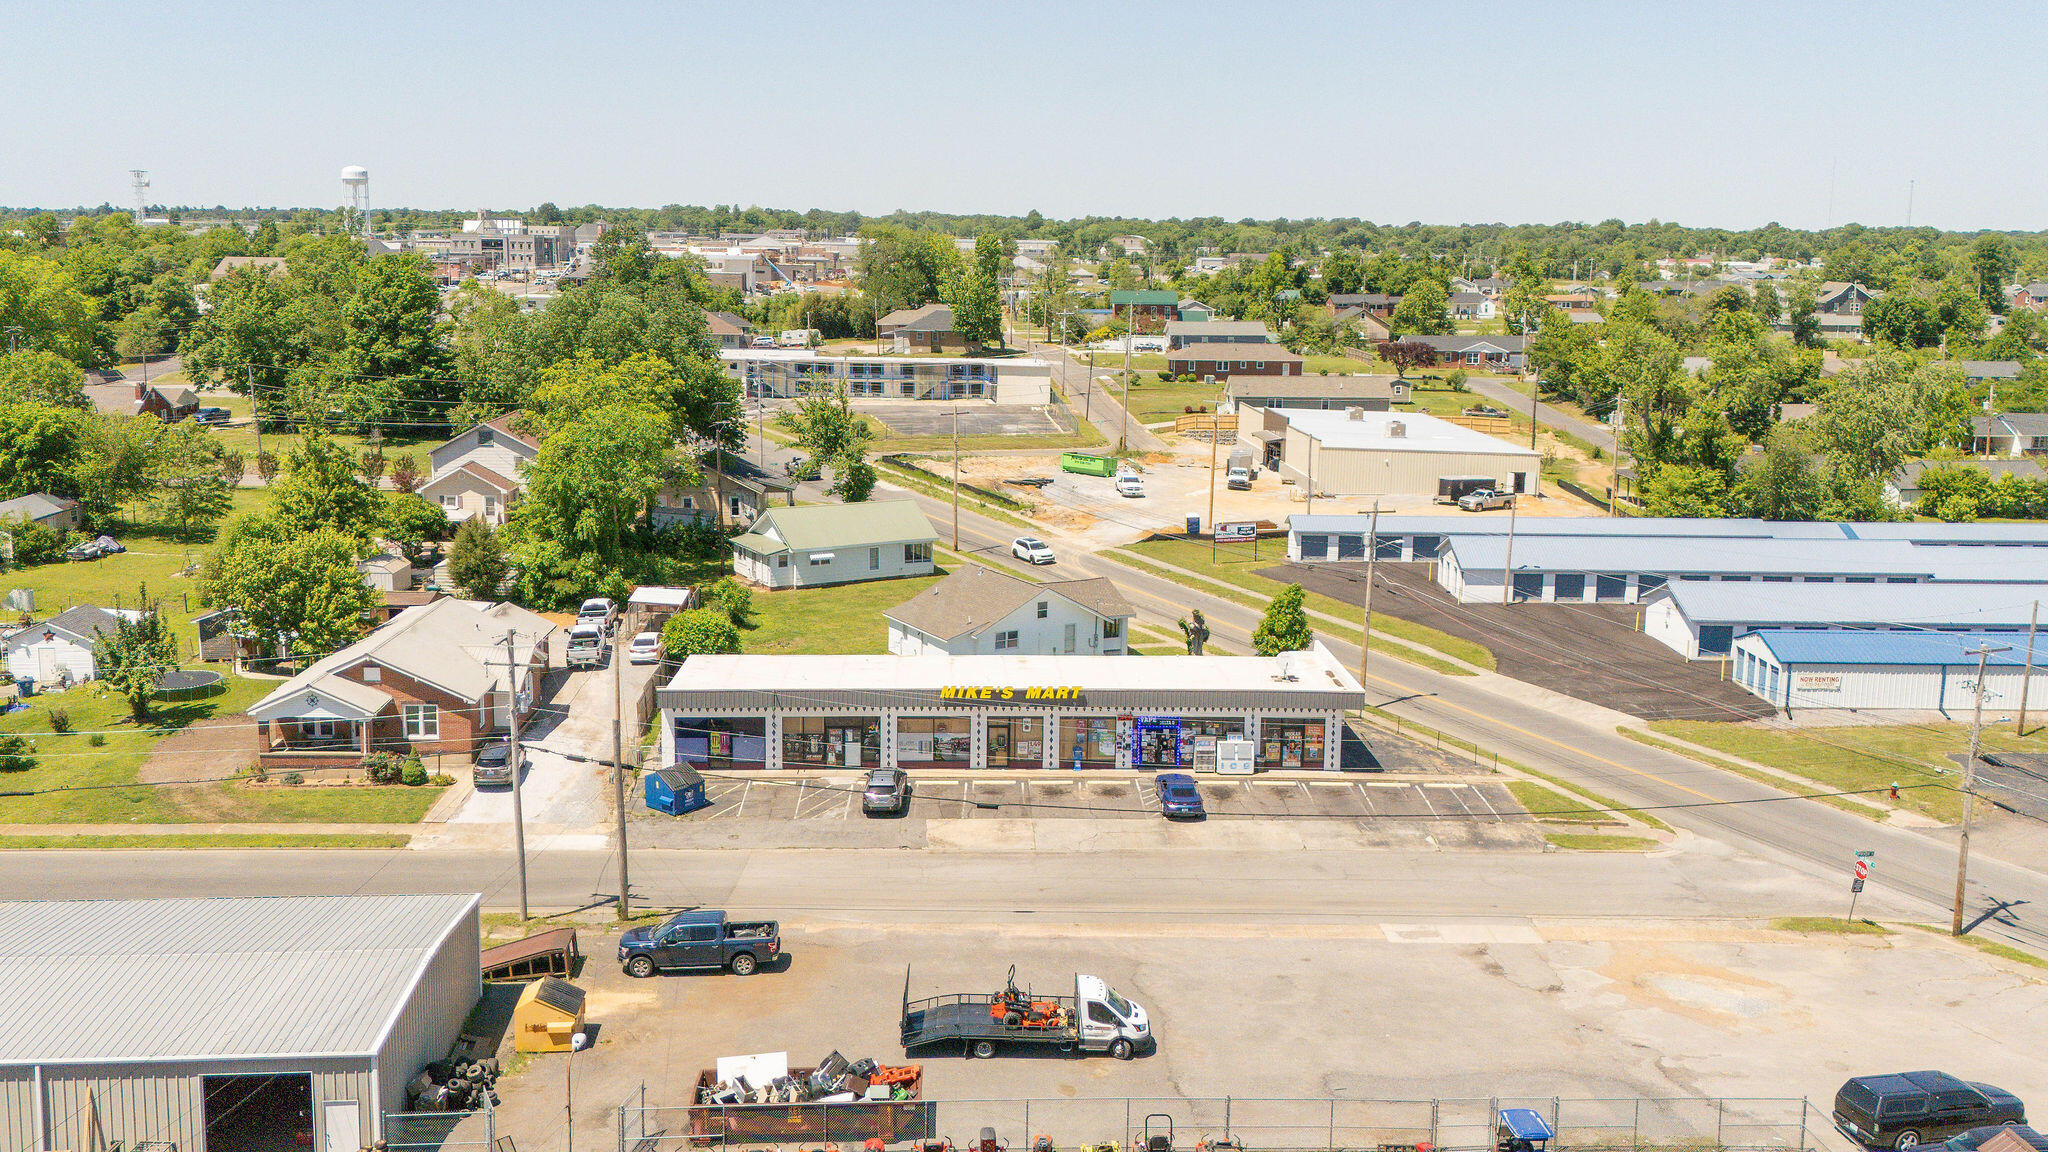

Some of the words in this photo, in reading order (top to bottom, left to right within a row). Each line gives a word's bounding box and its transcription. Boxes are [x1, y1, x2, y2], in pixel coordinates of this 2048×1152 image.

[940, 685, 1014, 699] MIKE'S
[1025, 685, 1082, 699] MART
[1221, 762, 1250, 770] ICE
[1854, 863, 1868, 876] STOP
